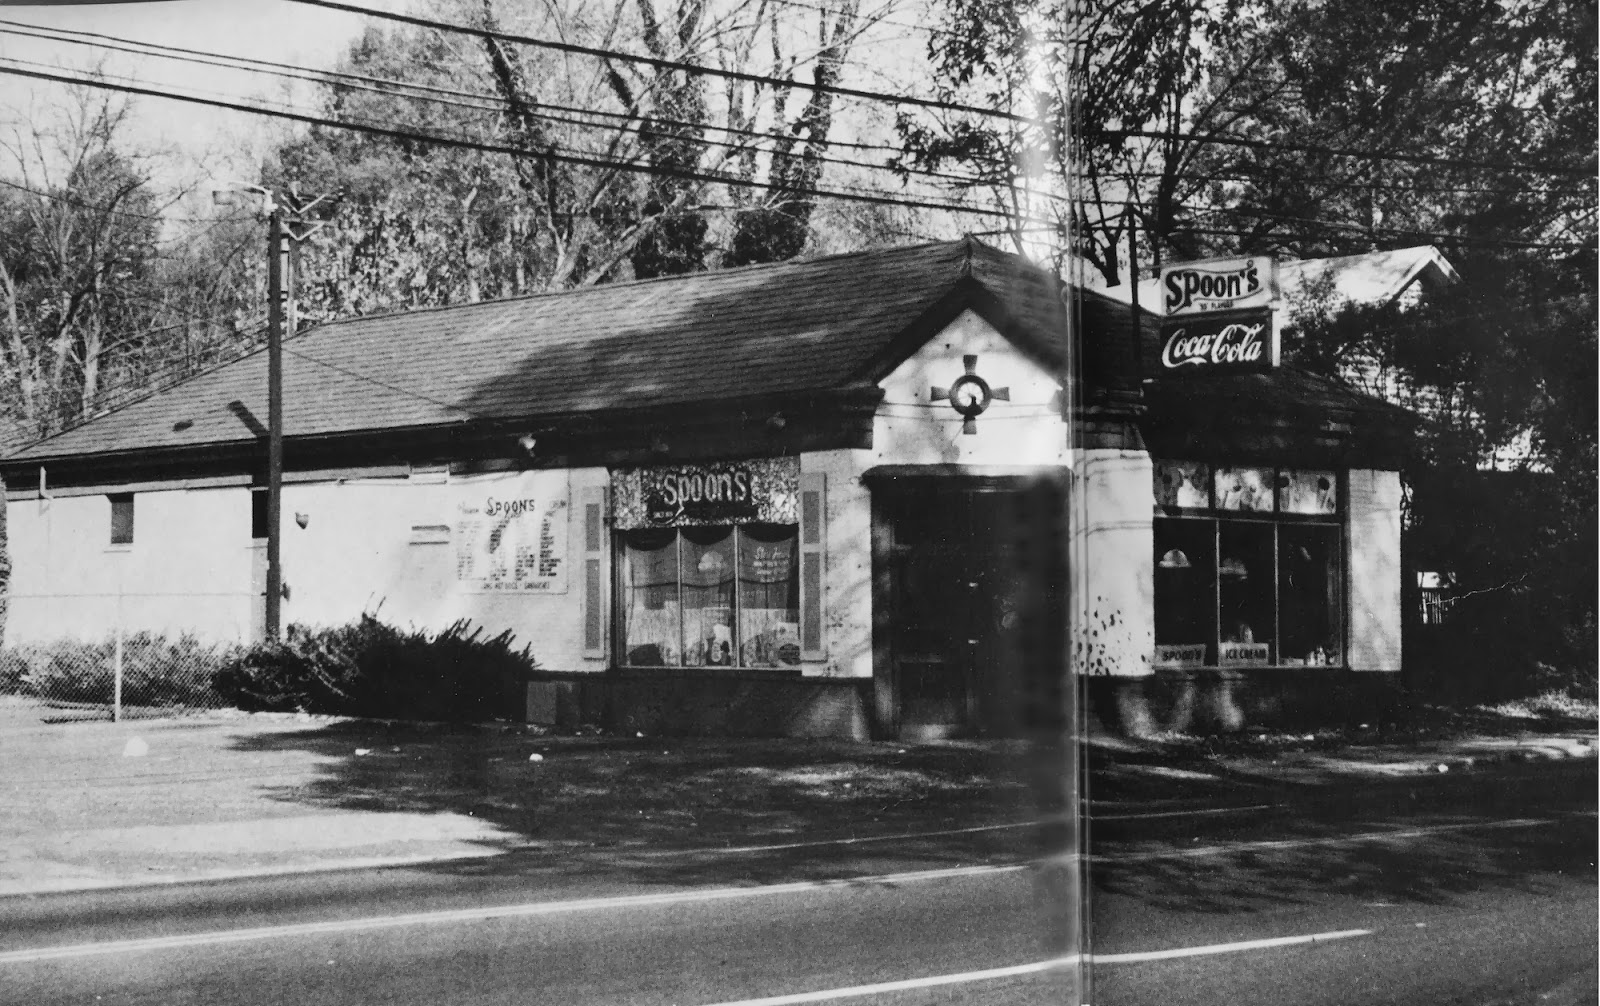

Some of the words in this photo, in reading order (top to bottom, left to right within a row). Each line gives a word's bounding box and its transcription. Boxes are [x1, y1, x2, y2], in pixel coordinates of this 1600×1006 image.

[1165, 266, 1260, 315] Spoon's
[1162, 323, 1265, 368] Coca-Cola
[1225, 649, 1238, 659] ICE
[1239, 648, 1267, 659] CREAM
